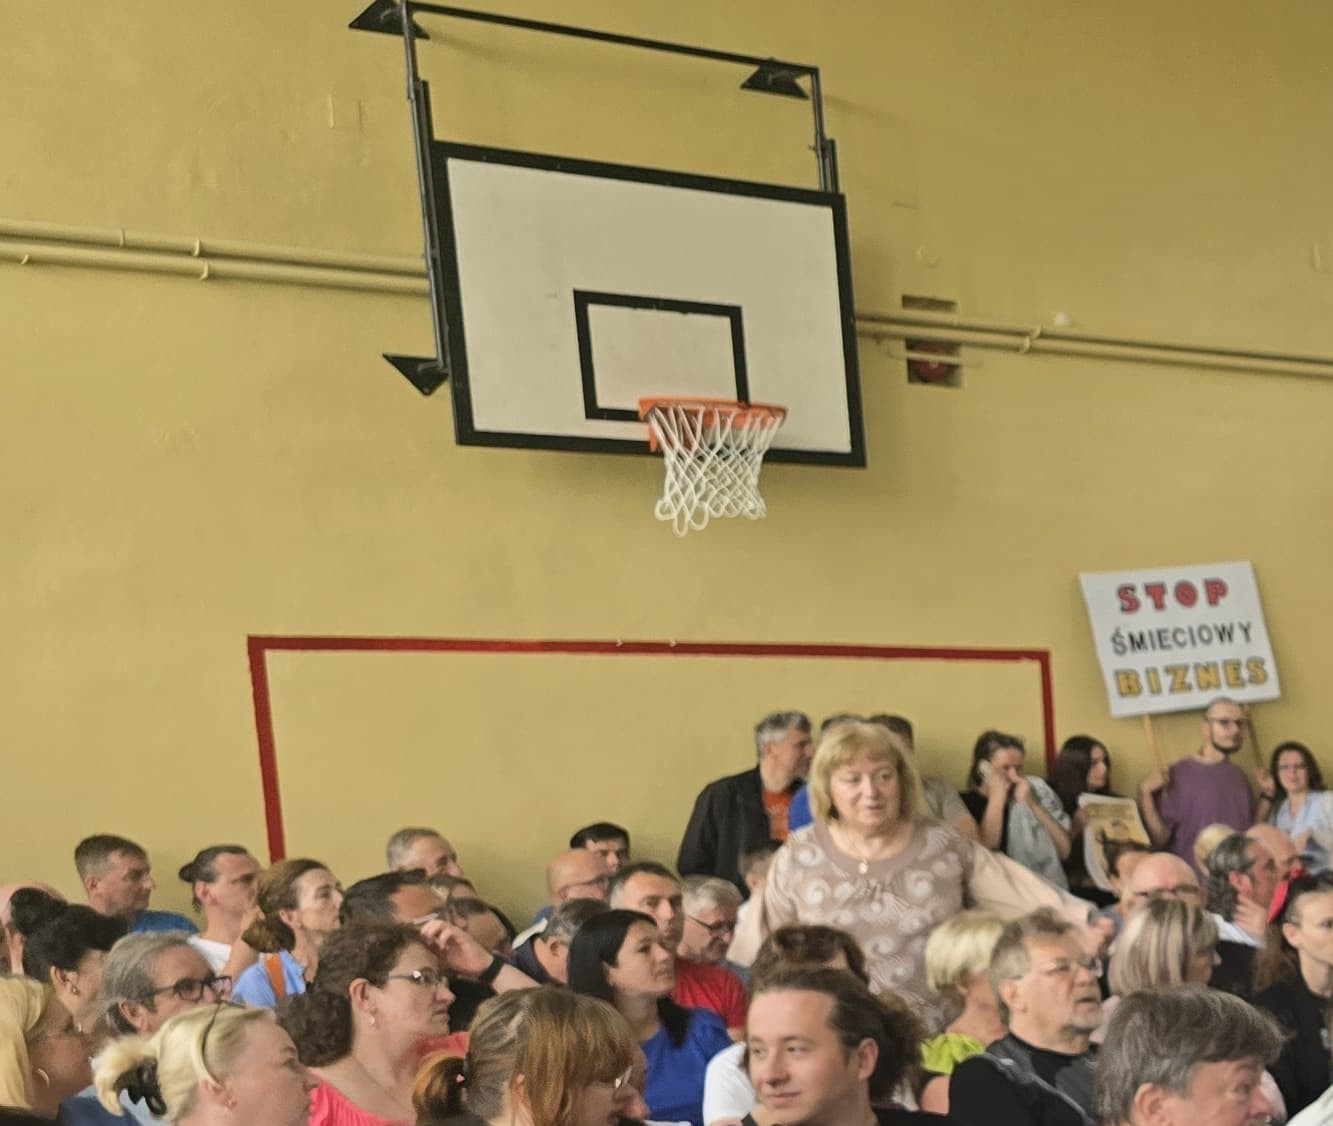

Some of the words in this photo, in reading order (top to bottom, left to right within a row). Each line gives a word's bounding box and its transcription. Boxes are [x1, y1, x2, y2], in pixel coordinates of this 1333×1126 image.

[1116, 577, 1229, 615] STOP
[1110, 620, 1252, 655] ŚMIECIOWY
[1113, 656, 1269, 697] BIZNES
